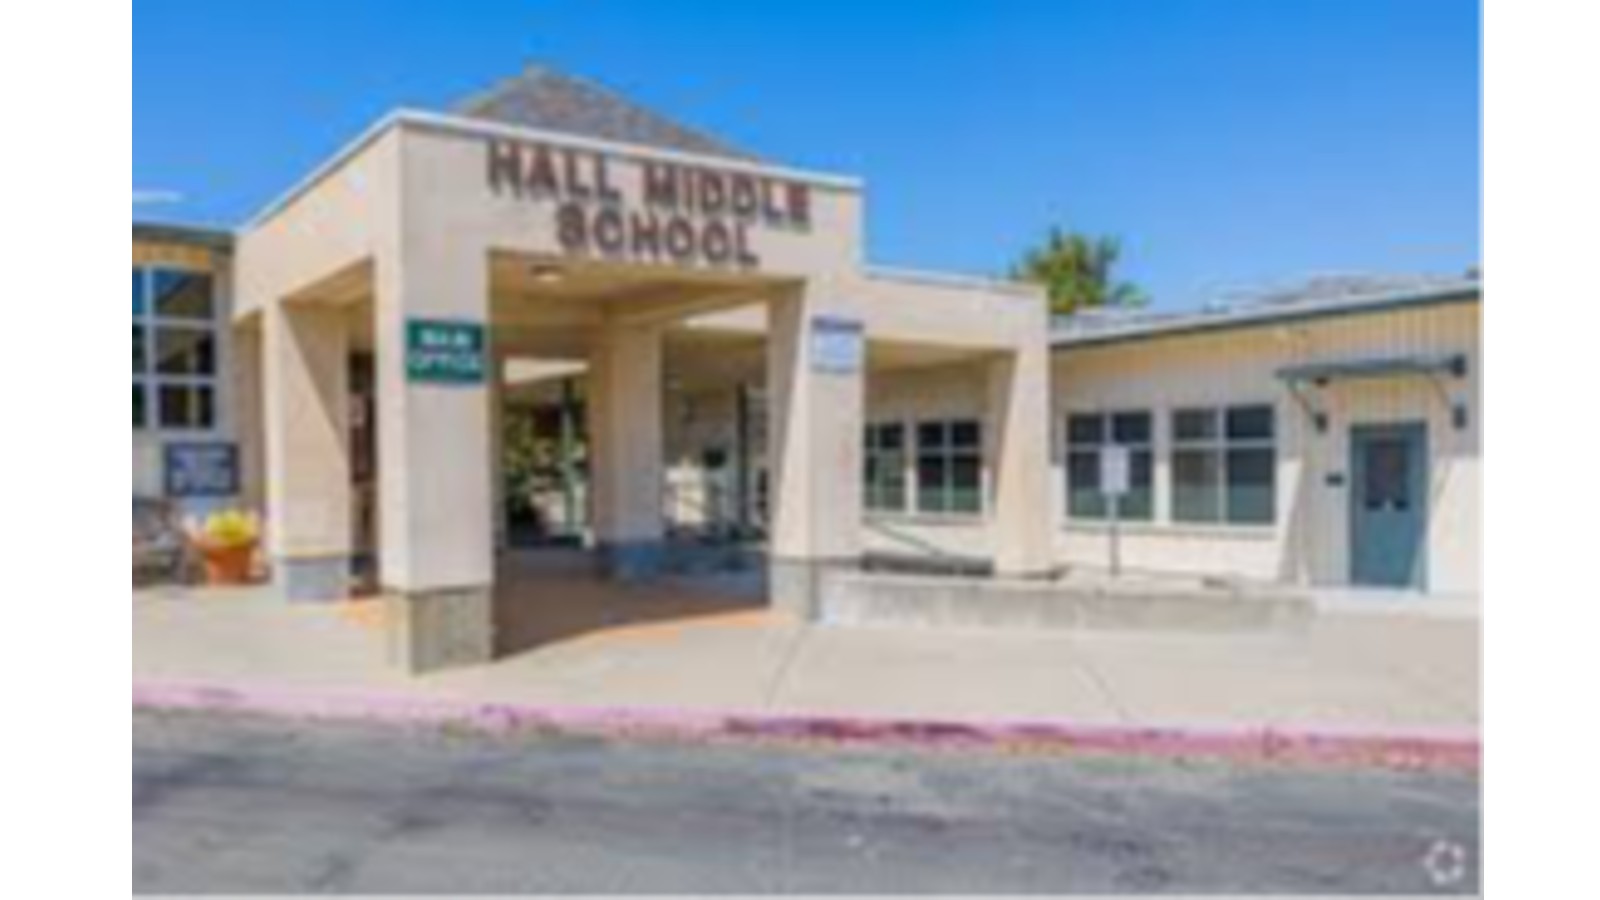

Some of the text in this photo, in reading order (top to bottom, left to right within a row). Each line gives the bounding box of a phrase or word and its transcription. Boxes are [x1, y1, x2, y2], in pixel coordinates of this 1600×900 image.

[487, 139, 812, 231] HALL MIDDLE
[555, 202, 760, 267] SCHOOL
